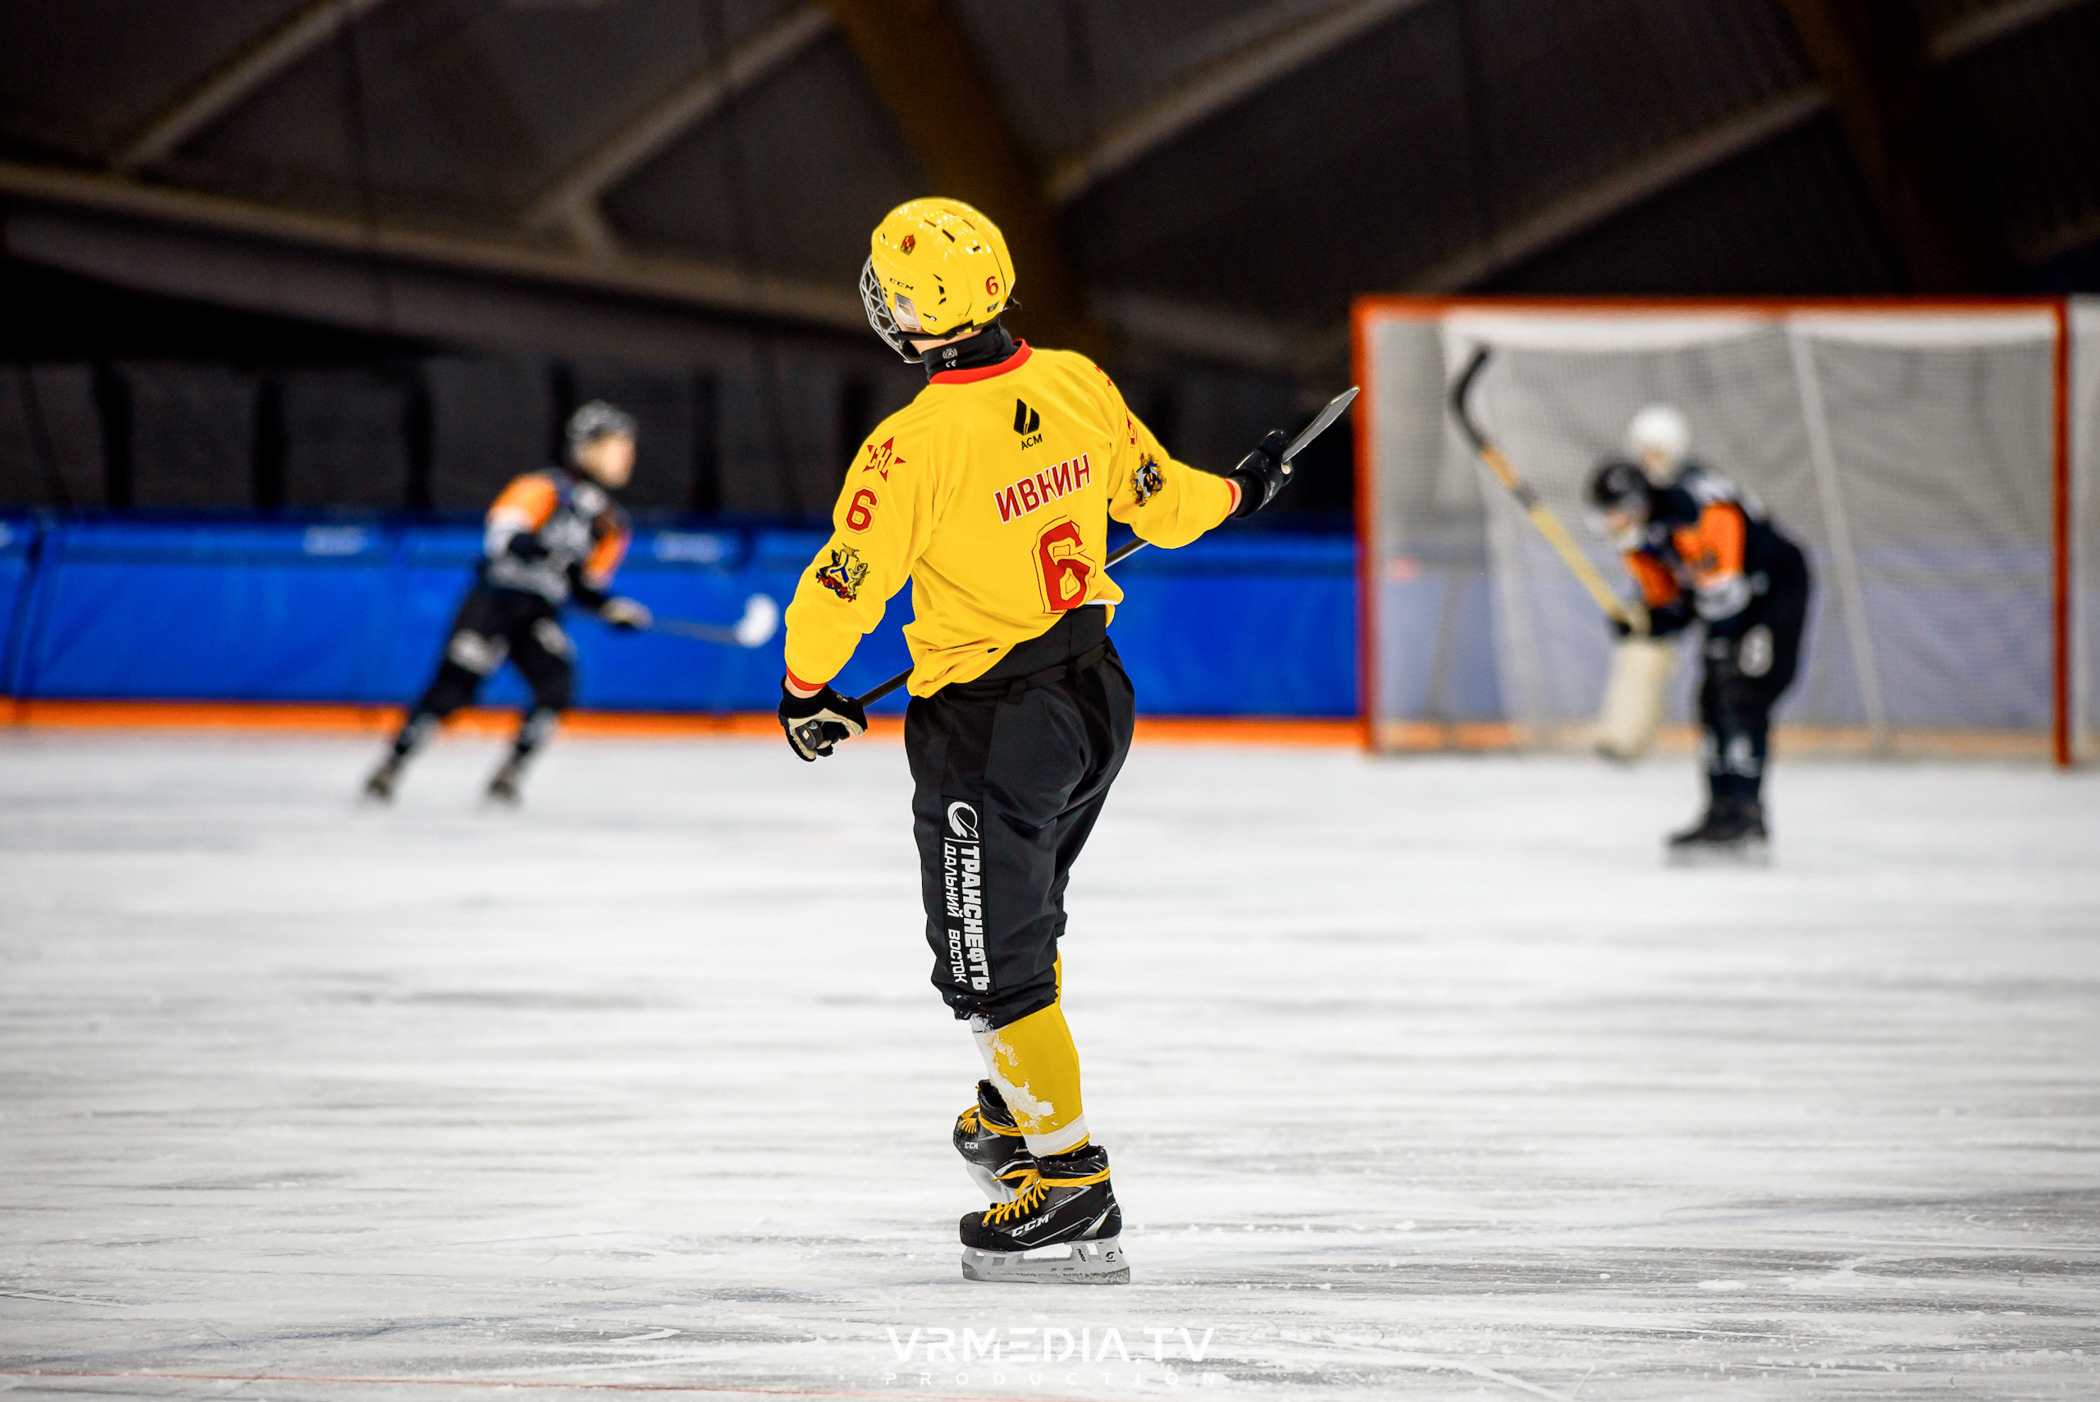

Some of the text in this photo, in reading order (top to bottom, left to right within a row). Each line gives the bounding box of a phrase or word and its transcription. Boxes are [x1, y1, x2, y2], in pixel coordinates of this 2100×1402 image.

[889, 277, 914, 291] CCM
[985, 276, 999, 296] 6
[845, 487, 879, 533] 6
[993, 452, 1091, 525] ИВКИН
[1032, 515, 1095, 614] 6
[944, 842, 967, 984] ДАЛЬНИЙ ВОСТОК
[961, 845, 990, 991] ТРАНСНЕФТЬ
[1011, 1214, 1050, 1238] CCM
